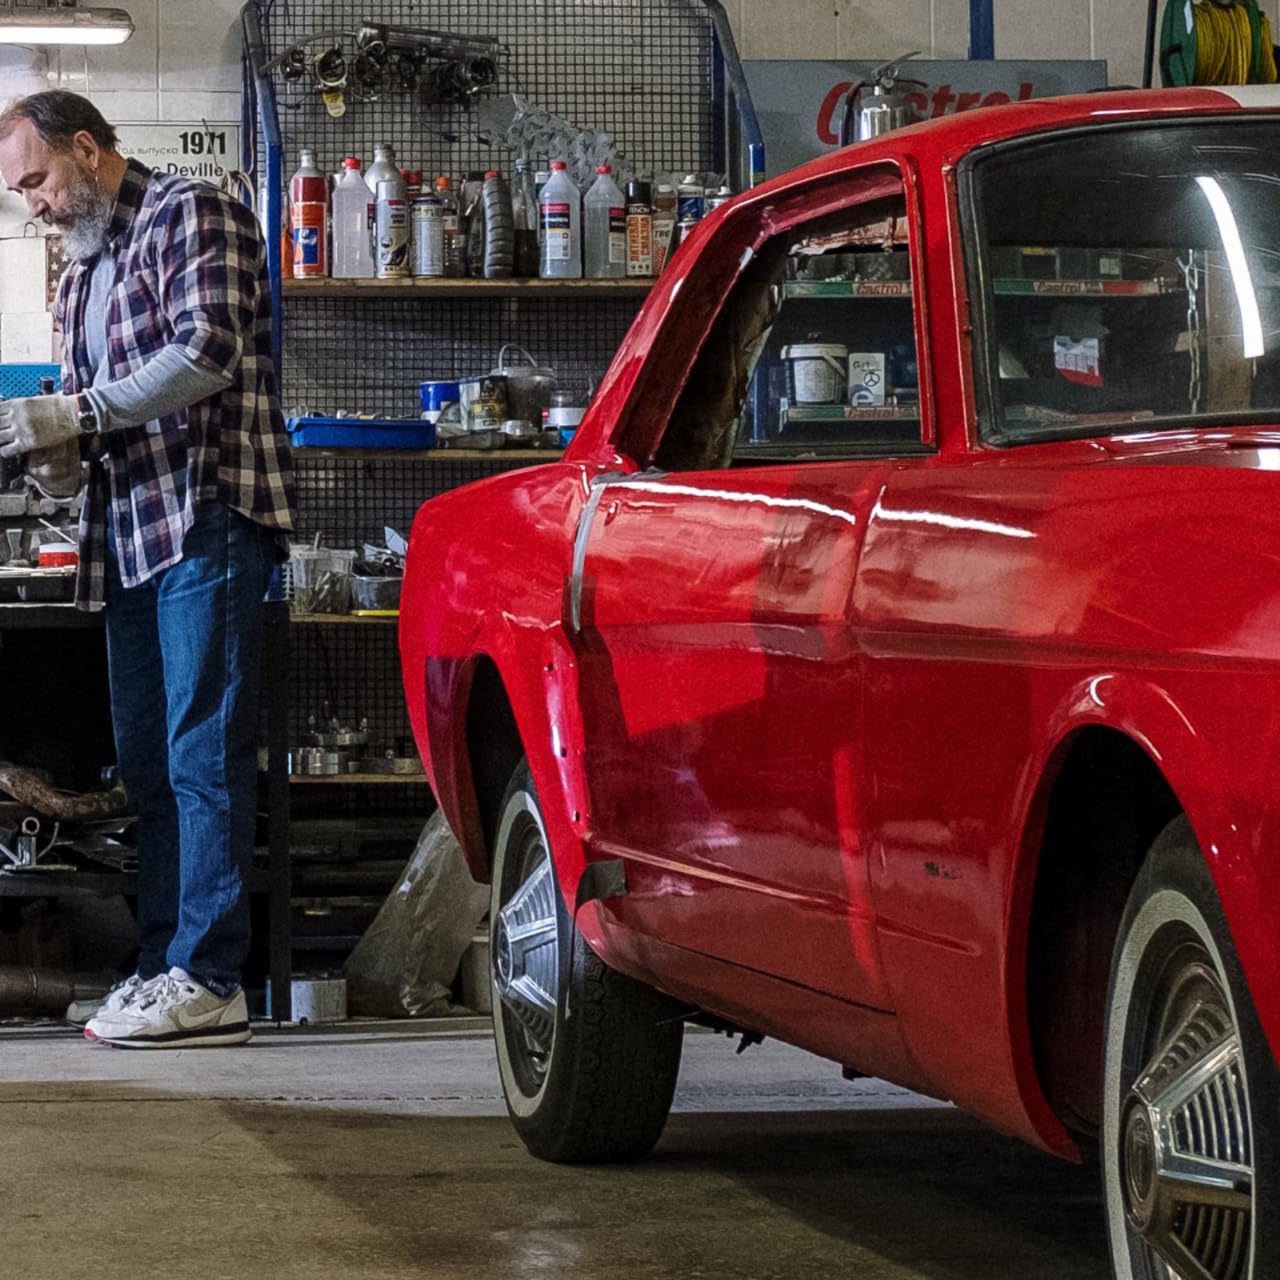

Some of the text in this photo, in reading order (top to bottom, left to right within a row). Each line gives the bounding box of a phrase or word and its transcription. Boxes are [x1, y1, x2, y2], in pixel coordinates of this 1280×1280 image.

[178, 131, 226, 155] 1971
[137, 146, 179, 157] выпуска
[166, 162, 225, 178] Deville
[857, 283, 904, 296] Castrol
